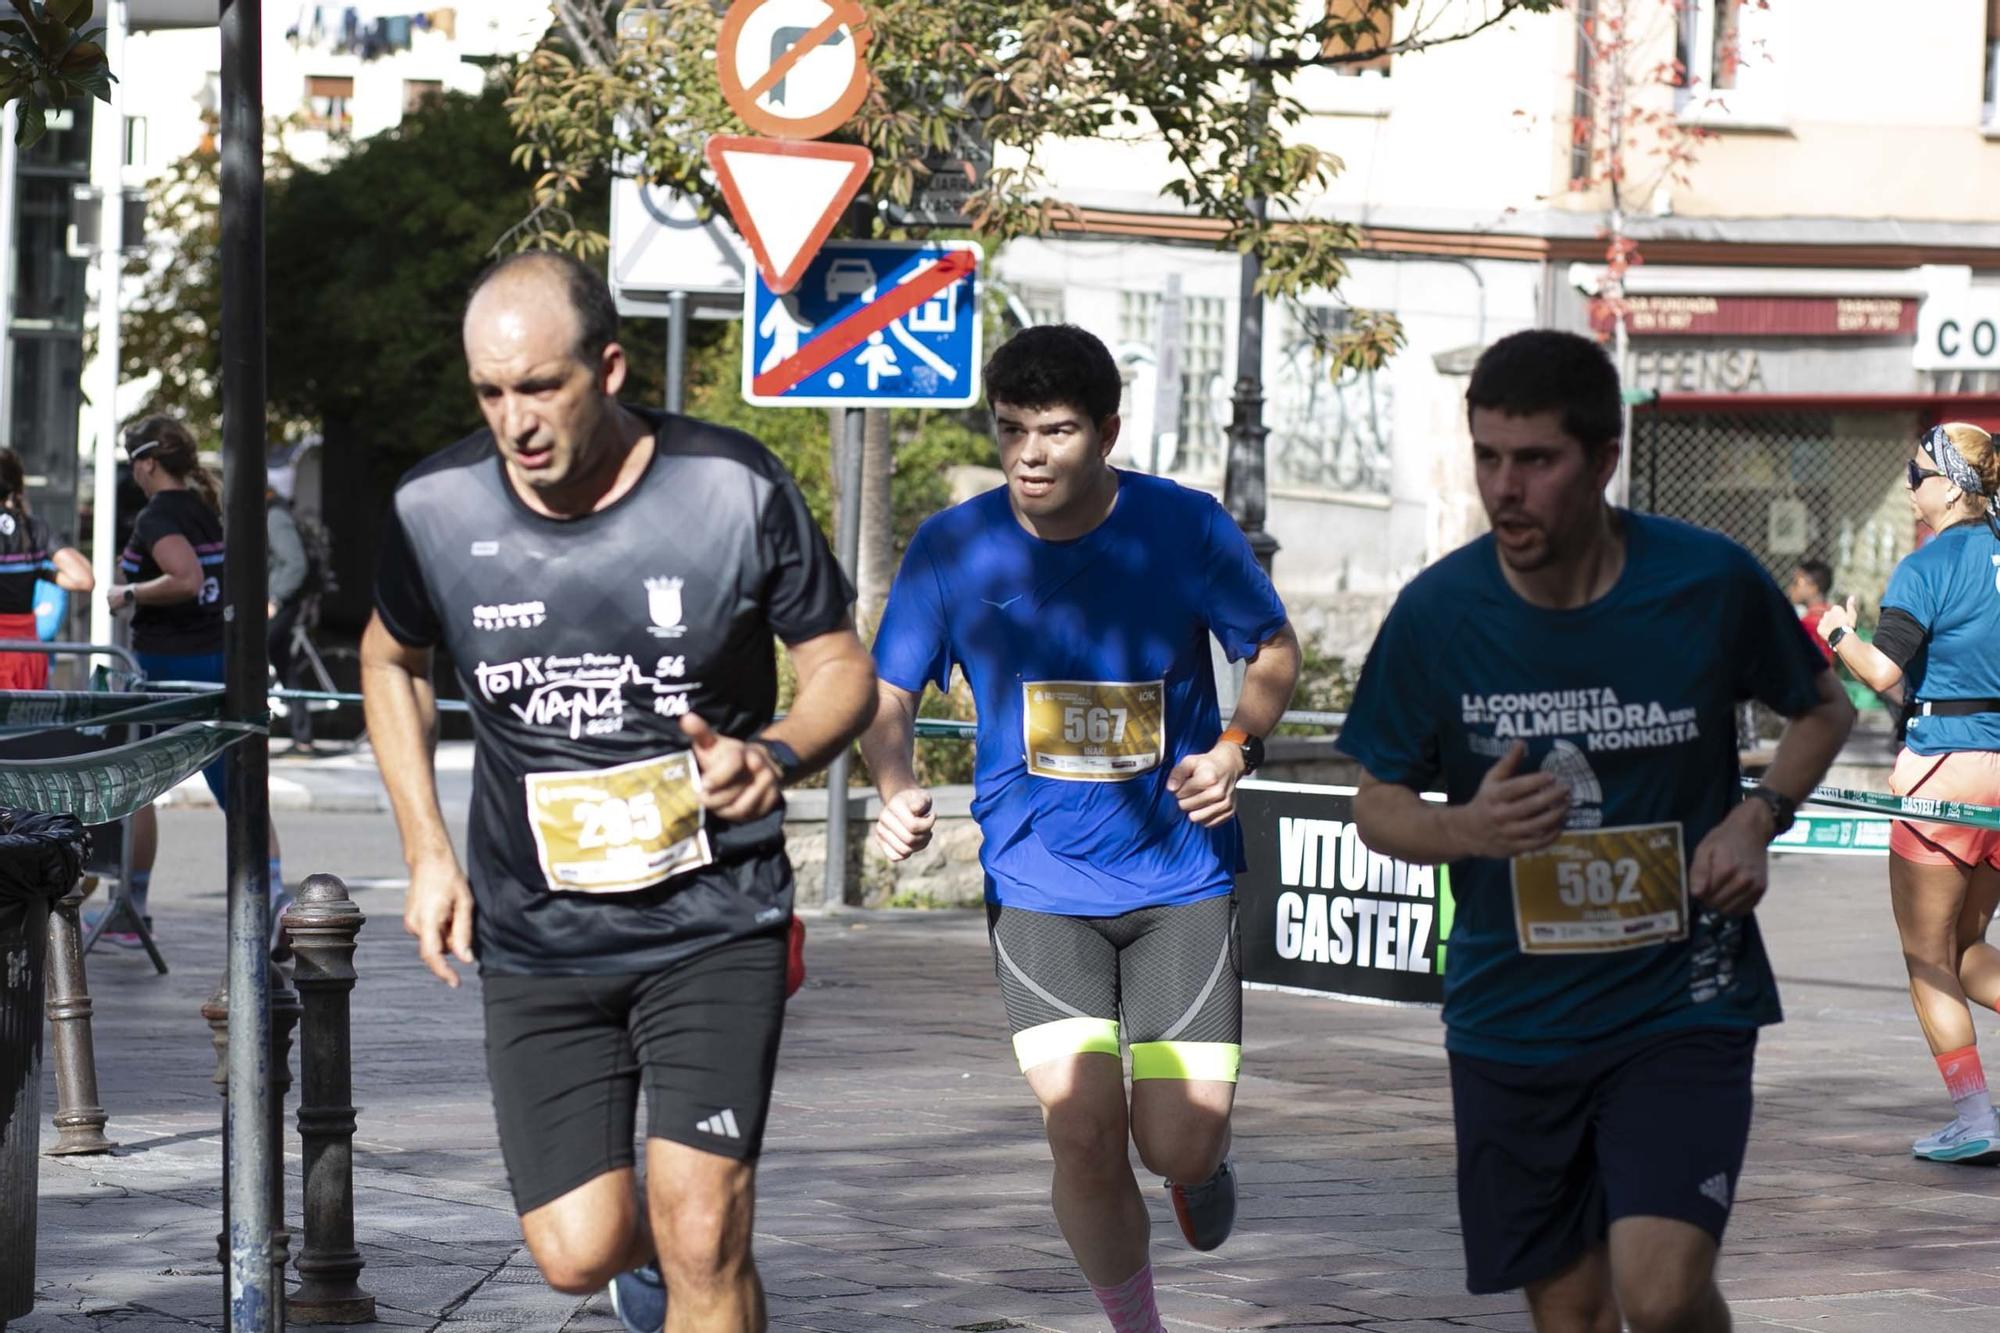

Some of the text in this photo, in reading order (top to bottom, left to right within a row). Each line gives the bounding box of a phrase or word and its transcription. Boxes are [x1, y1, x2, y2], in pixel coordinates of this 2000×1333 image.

[1462, 687, 1619, 713] LA CONQUISTA
[1064, 707, 1128, 743] 567
[1495, 702, 1667, 737] ALMENDRA
[1587, 722, 1700, 751] KONKISTA
[1557, 858, 1642, 907] 582
[1276, 891, 1433, 973] GASTEIZ
